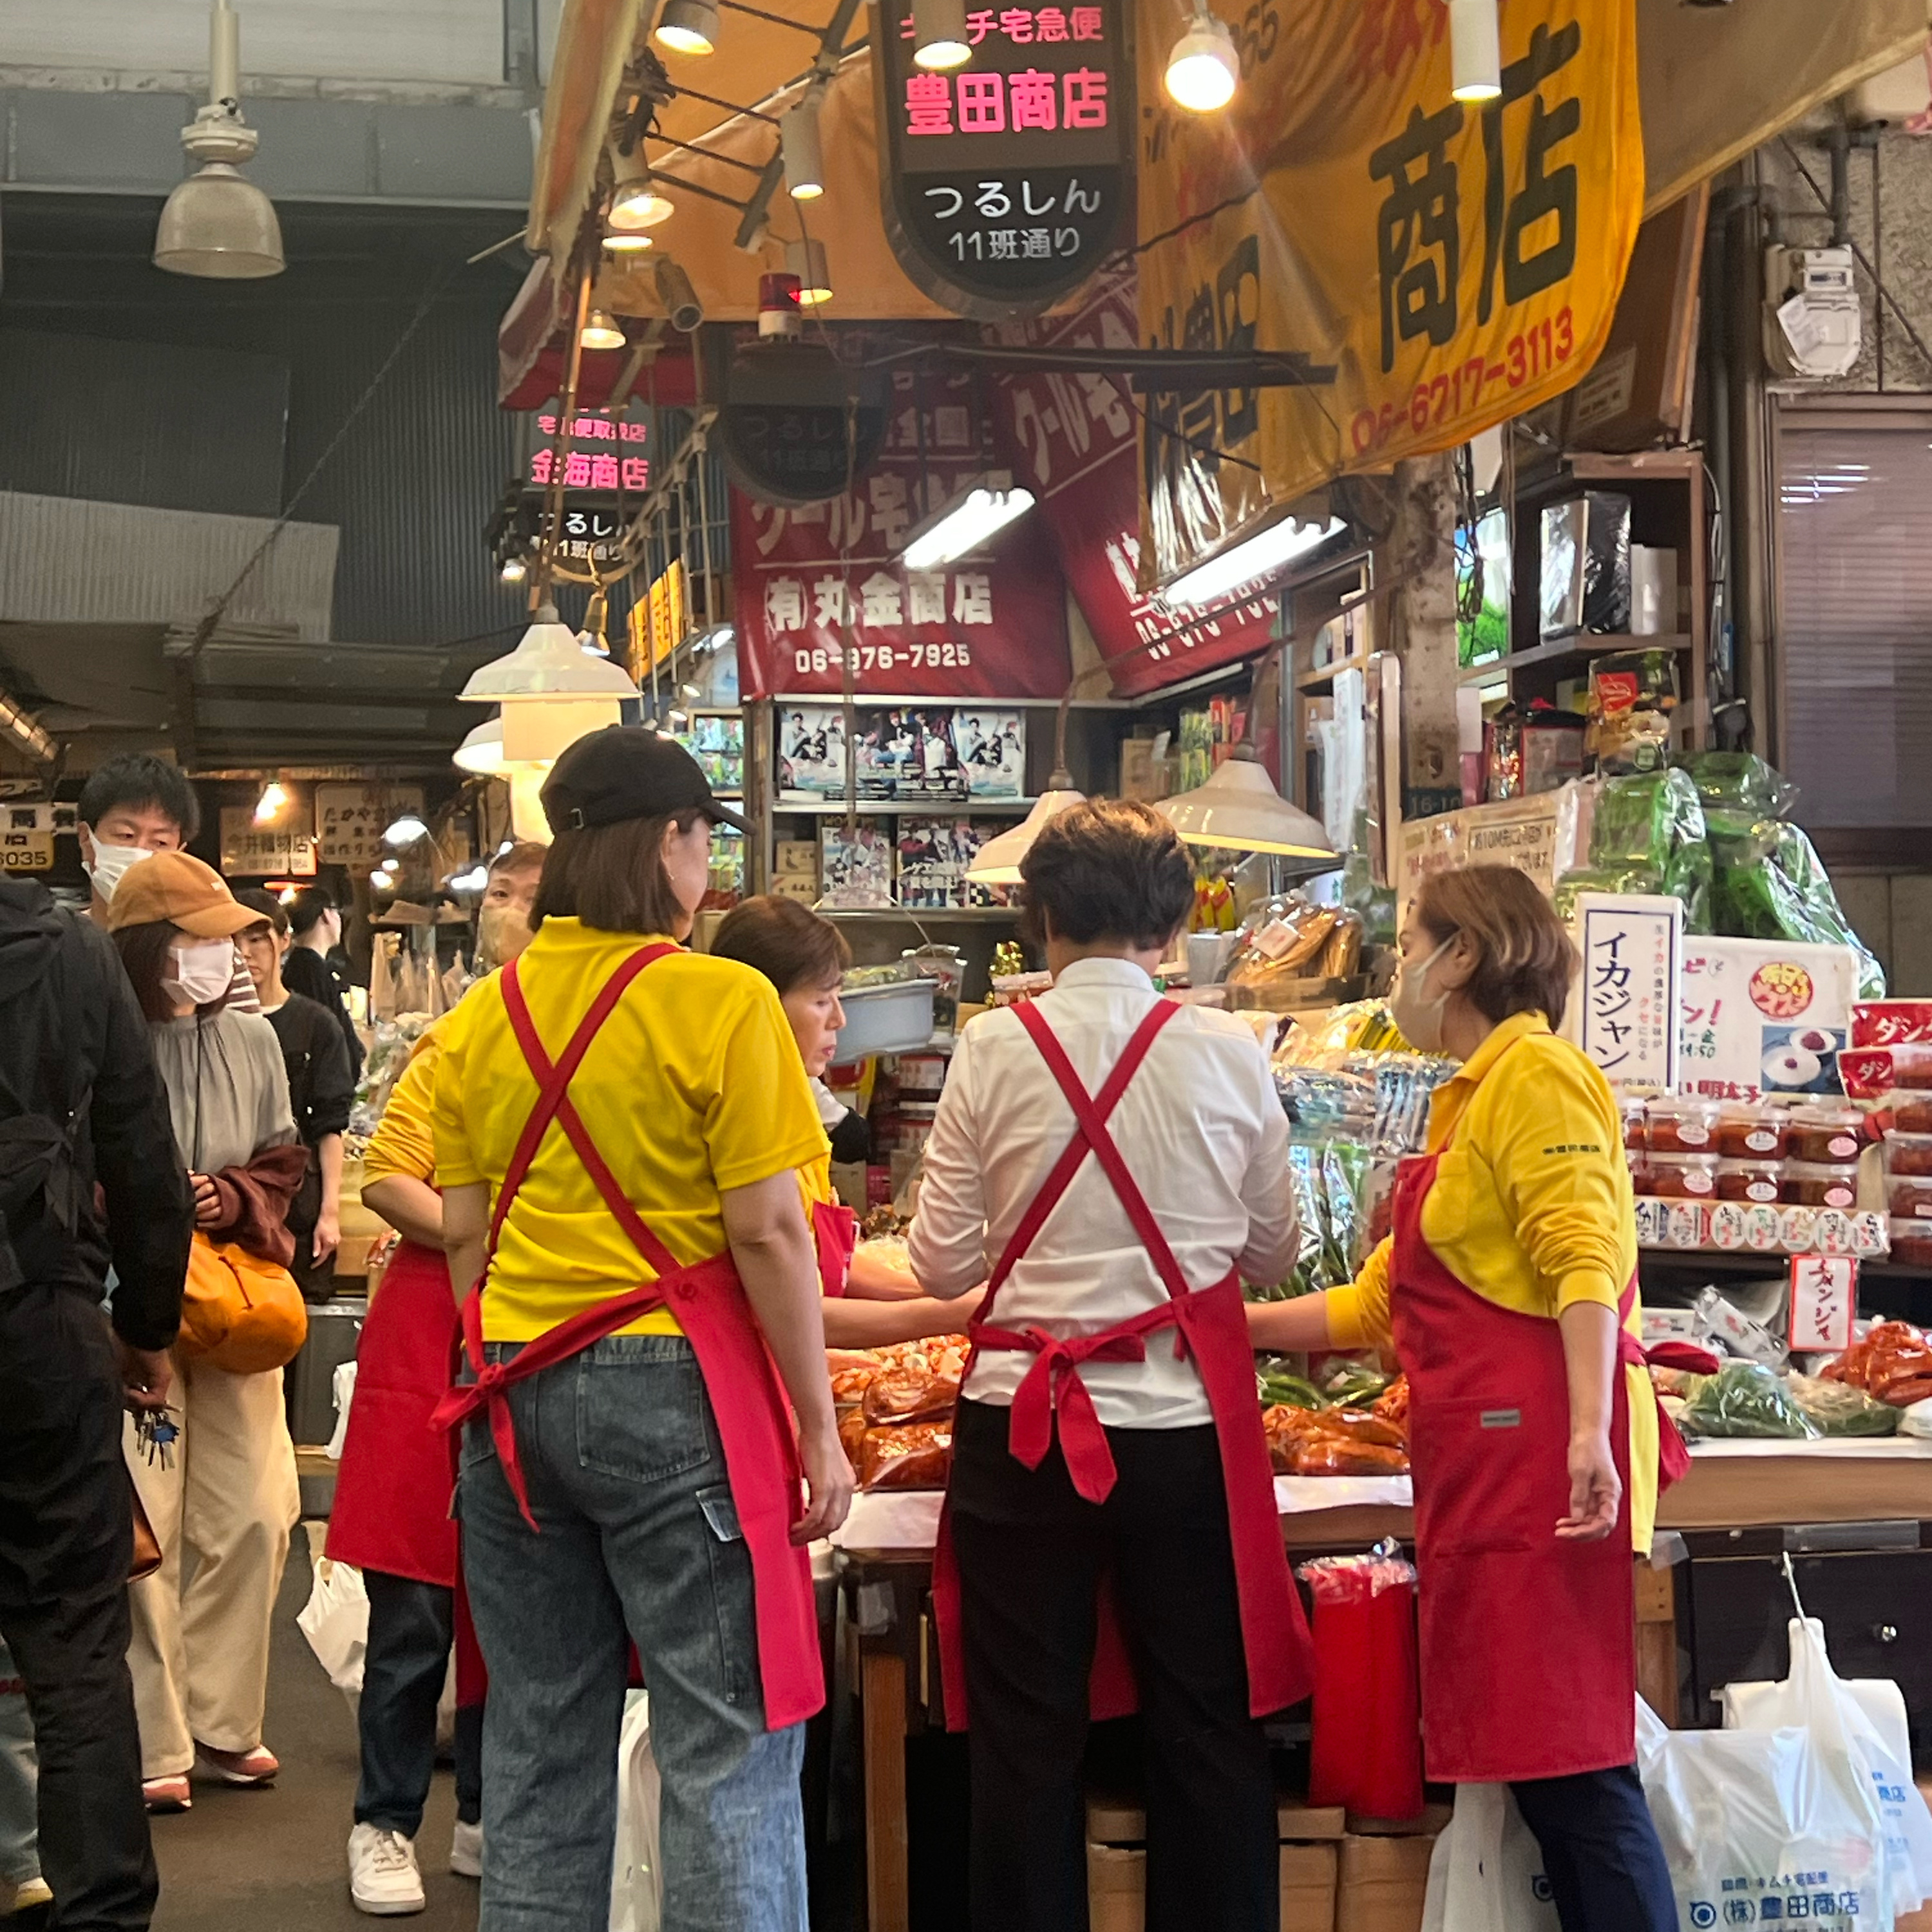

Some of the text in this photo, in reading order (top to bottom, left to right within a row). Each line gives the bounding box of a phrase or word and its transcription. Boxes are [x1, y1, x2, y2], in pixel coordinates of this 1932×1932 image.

[900, 8, 1104, 44] チ宅急便
[905, 67, 1107, 135] 豊田商店
[924, 178, 1101, 218] つるしん
[949, 227, 1080, 260] 11班通り
[1351, 306, 1573, 455] 06-6717-3113
[1593, 931, 1632, 1070] イカジャン
